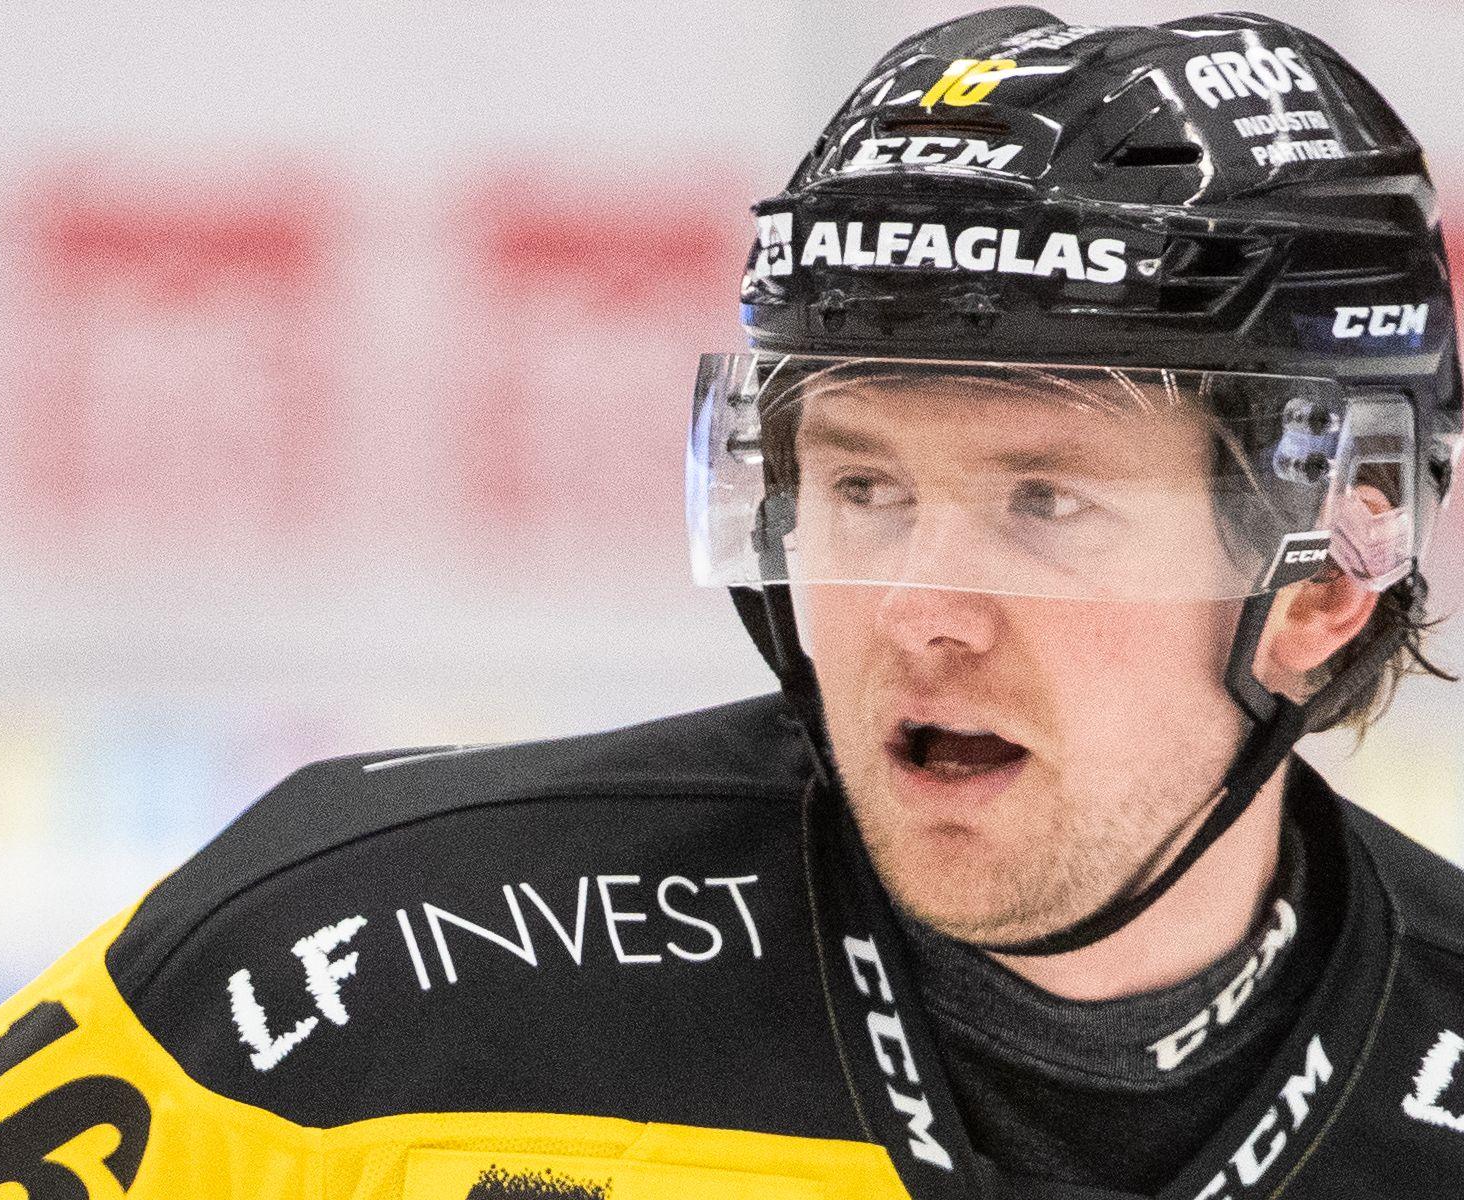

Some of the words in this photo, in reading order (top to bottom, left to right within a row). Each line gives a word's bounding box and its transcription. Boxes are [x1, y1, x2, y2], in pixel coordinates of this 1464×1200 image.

[919, 58, 1018, 107] 16
[849, 136, 1024, 172] CCM
[801, 222, 1128, 285] ALFAGLAS
[1332, 303, 1429, 339] CCM
[1284, 549, 1329, 564] CCM
[227, 914, 368, 1072] LF
[396, 874, 760, 991] INVEST
[1146, 898, 1298, 1071] CCM
[843, 934, 953, 1172] CCM
